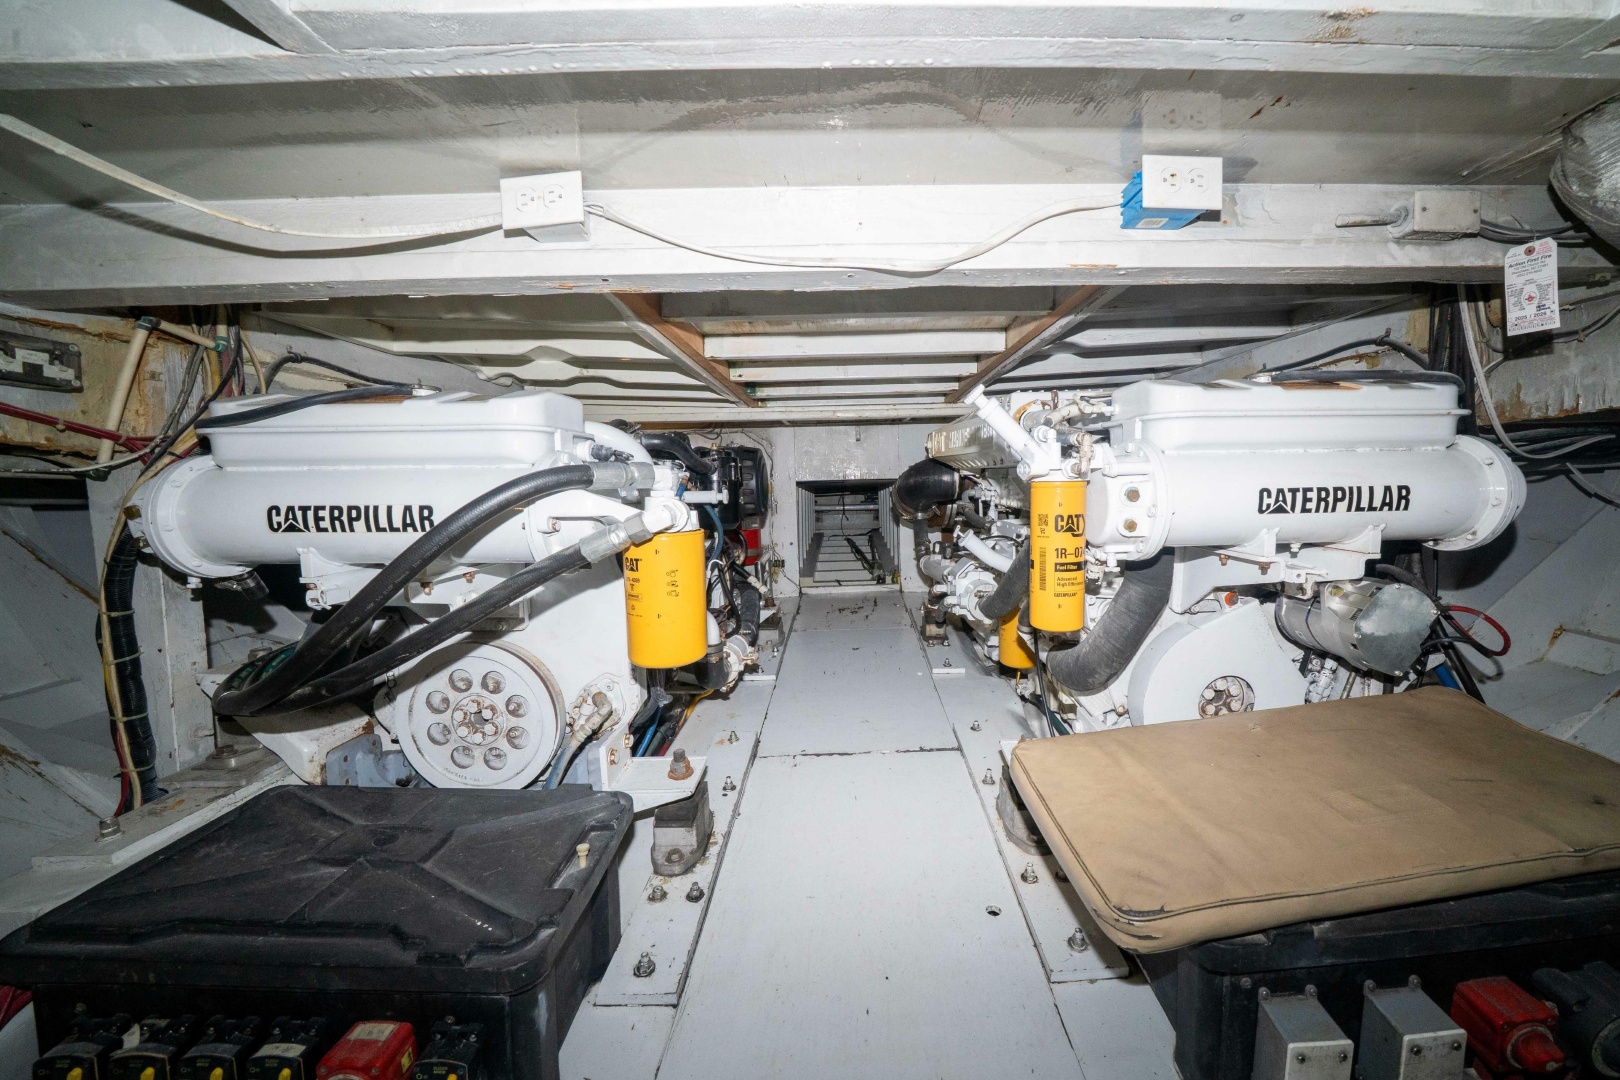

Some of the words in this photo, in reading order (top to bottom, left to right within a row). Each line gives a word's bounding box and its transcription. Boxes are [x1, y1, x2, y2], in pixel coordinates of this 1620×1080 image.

[1257, 485, 1411, 515] CATERPILLAR
[266, 504, 435, 533] CATERPILLAR
[1054, 513, 1082, 533] CAT
[1054, 547, 1084, 559] 1R-07
[624, 556, 640, 573] CAT
